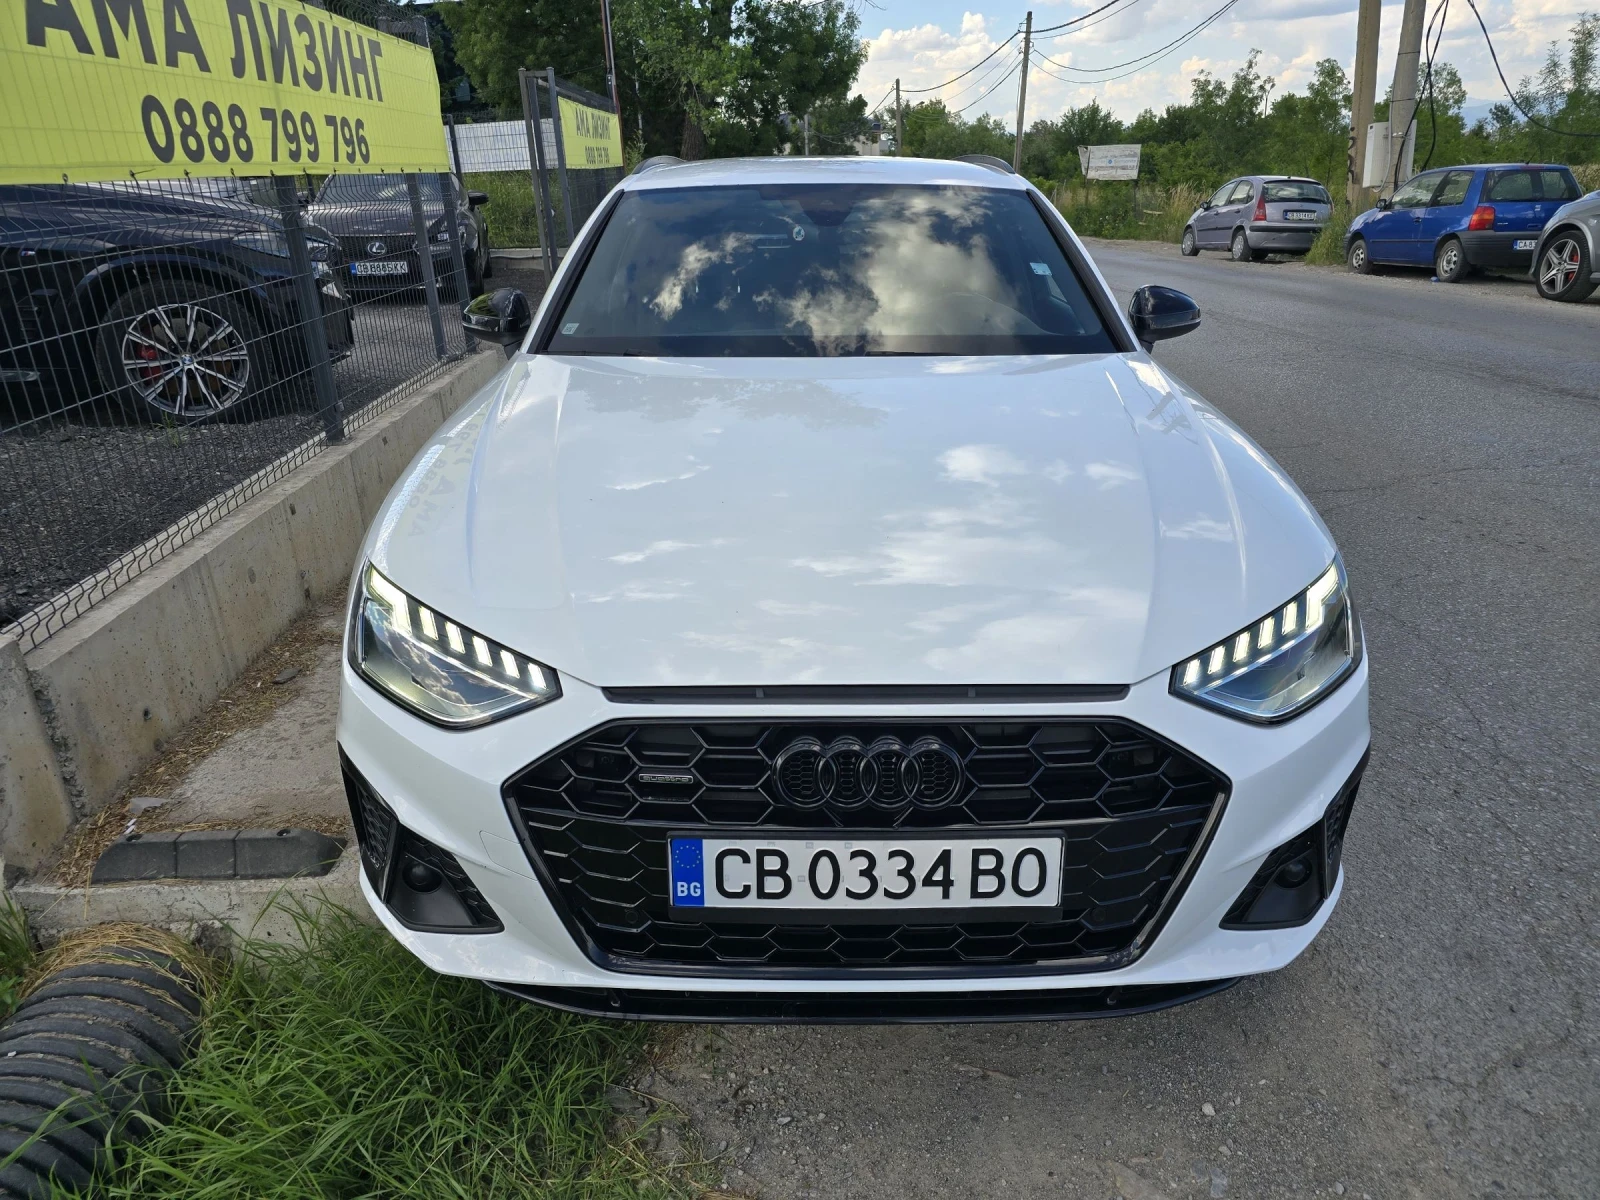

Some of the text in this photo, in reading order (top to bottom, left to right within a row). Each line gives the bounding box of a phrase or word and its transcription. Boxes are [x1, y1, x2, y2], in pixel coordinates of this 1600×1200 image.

[25, 0, 384, 103] АМА ЛИЗИНГ
[141, 94, 370, 164] 0888 799 796
[677, 881, 701, 897] BG
[714, 847, 793, 900] CB
[807, 848, 955, 900] 0334
